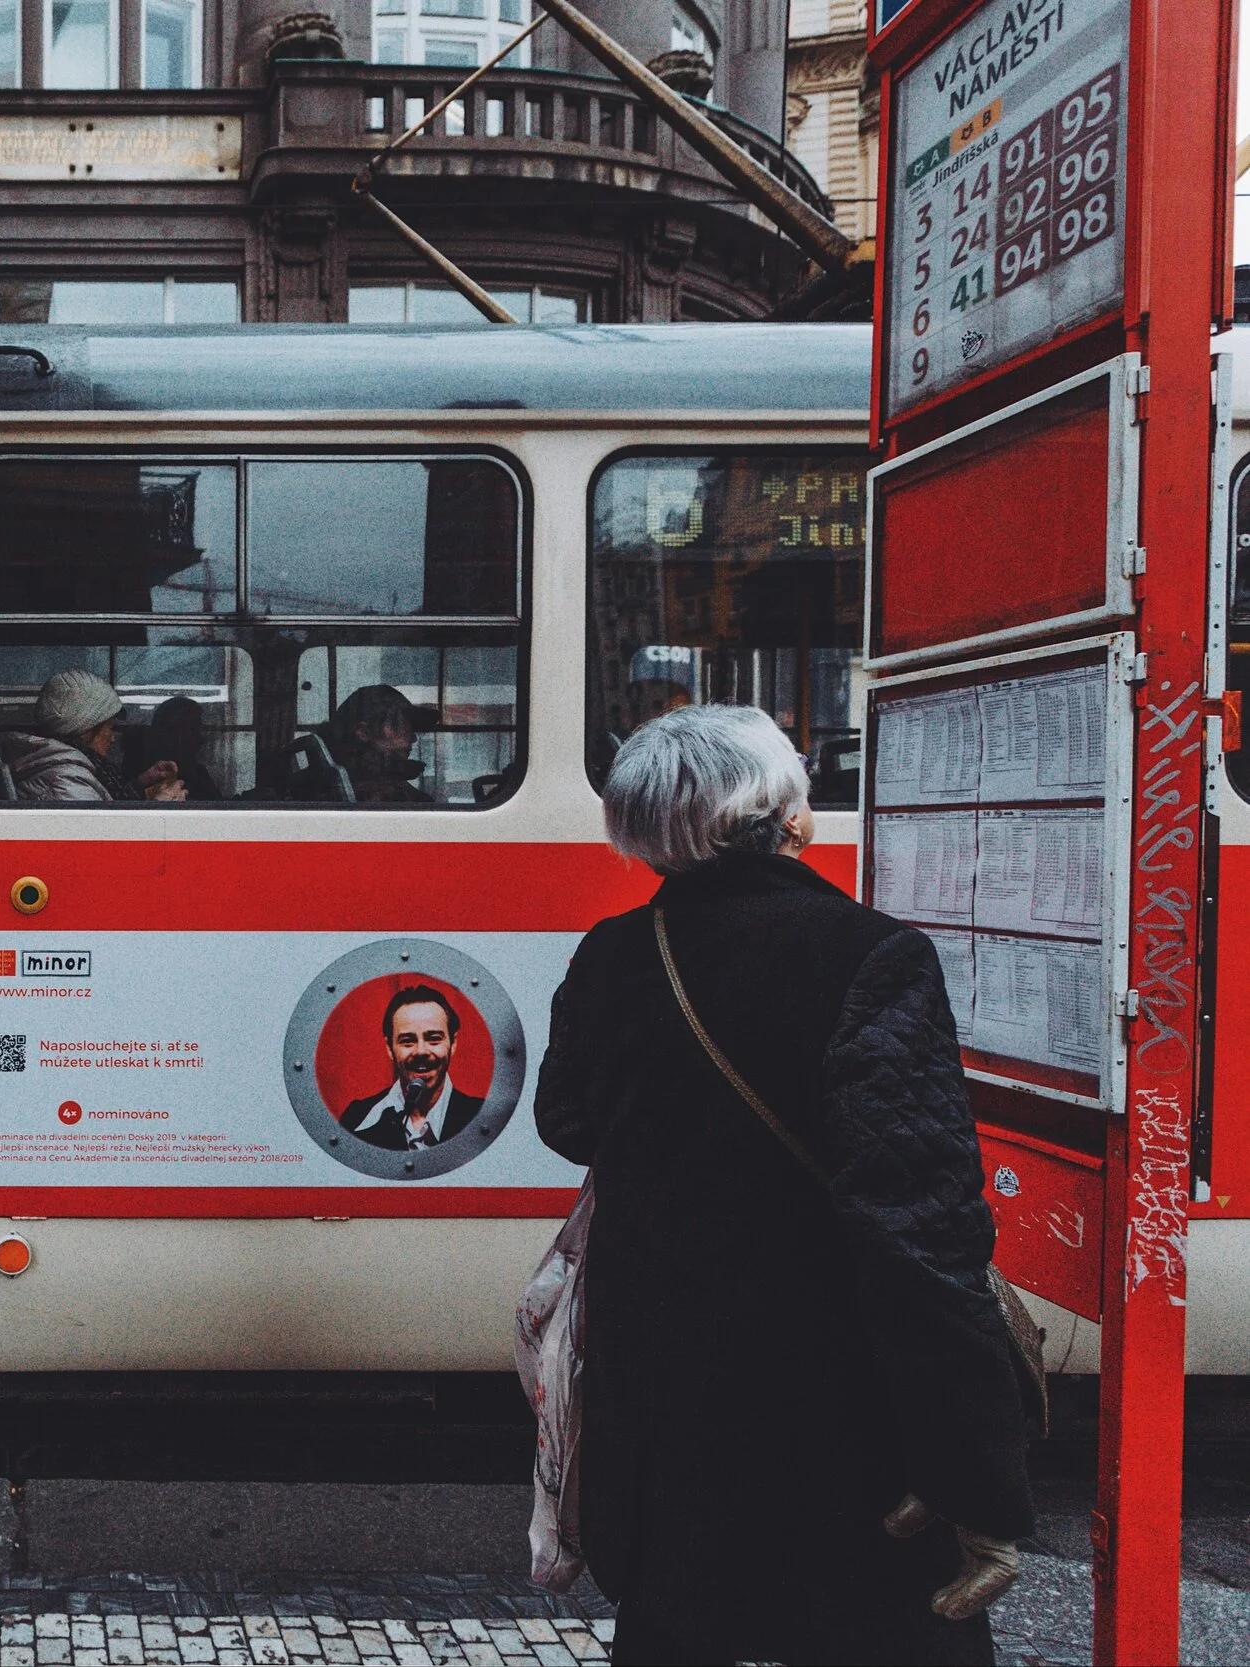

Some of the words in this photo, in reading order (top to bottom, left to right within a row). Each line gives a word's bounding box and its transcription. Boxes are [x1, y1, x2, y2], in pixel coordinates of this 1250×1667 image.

[950, 0, 1064, 118] NÁMĚSTÍ
[982, 110, 992, 128] B
[915, 202, 932, 244] 3
[953, 162, 992, 219] 14
[1004, 128, 1046, 183] 91
[1060, 75, 1113, 143] 95
[932, 129, 999, 188] Jindřišská
[914, 250, 932, 291] 5
[950, 213, 990, 268] 24
[1003, 177, 1046, 236] 92
[1058, 135, 1109, 200] 96
[913, 297, 930, 338] 6
[950, 264, 988, 313] 41
[1000, 236, 1045, 288] 94
[1058, 194, 1108, 257] 98
[912, 347, 929, 385] 9
[779, 515, 867, 546] Jin
[27, 956, 87, 971] minor
[40, 1040, 147, 1054] Naposlouchejte
[167, 1040, 181, 1052] ať
[184, 1042, 199, 1052] se
[40, 1056, 92, 1068] můžete
[95, 1056, 149, 1068] utleskat
[153, 1057, 161, 1068] k
[165, 1057, 204, 1068] smrti!
[88, 1108, 170, 1120] nominováno
[260, 1154, 304, 1163] 2018/2019
